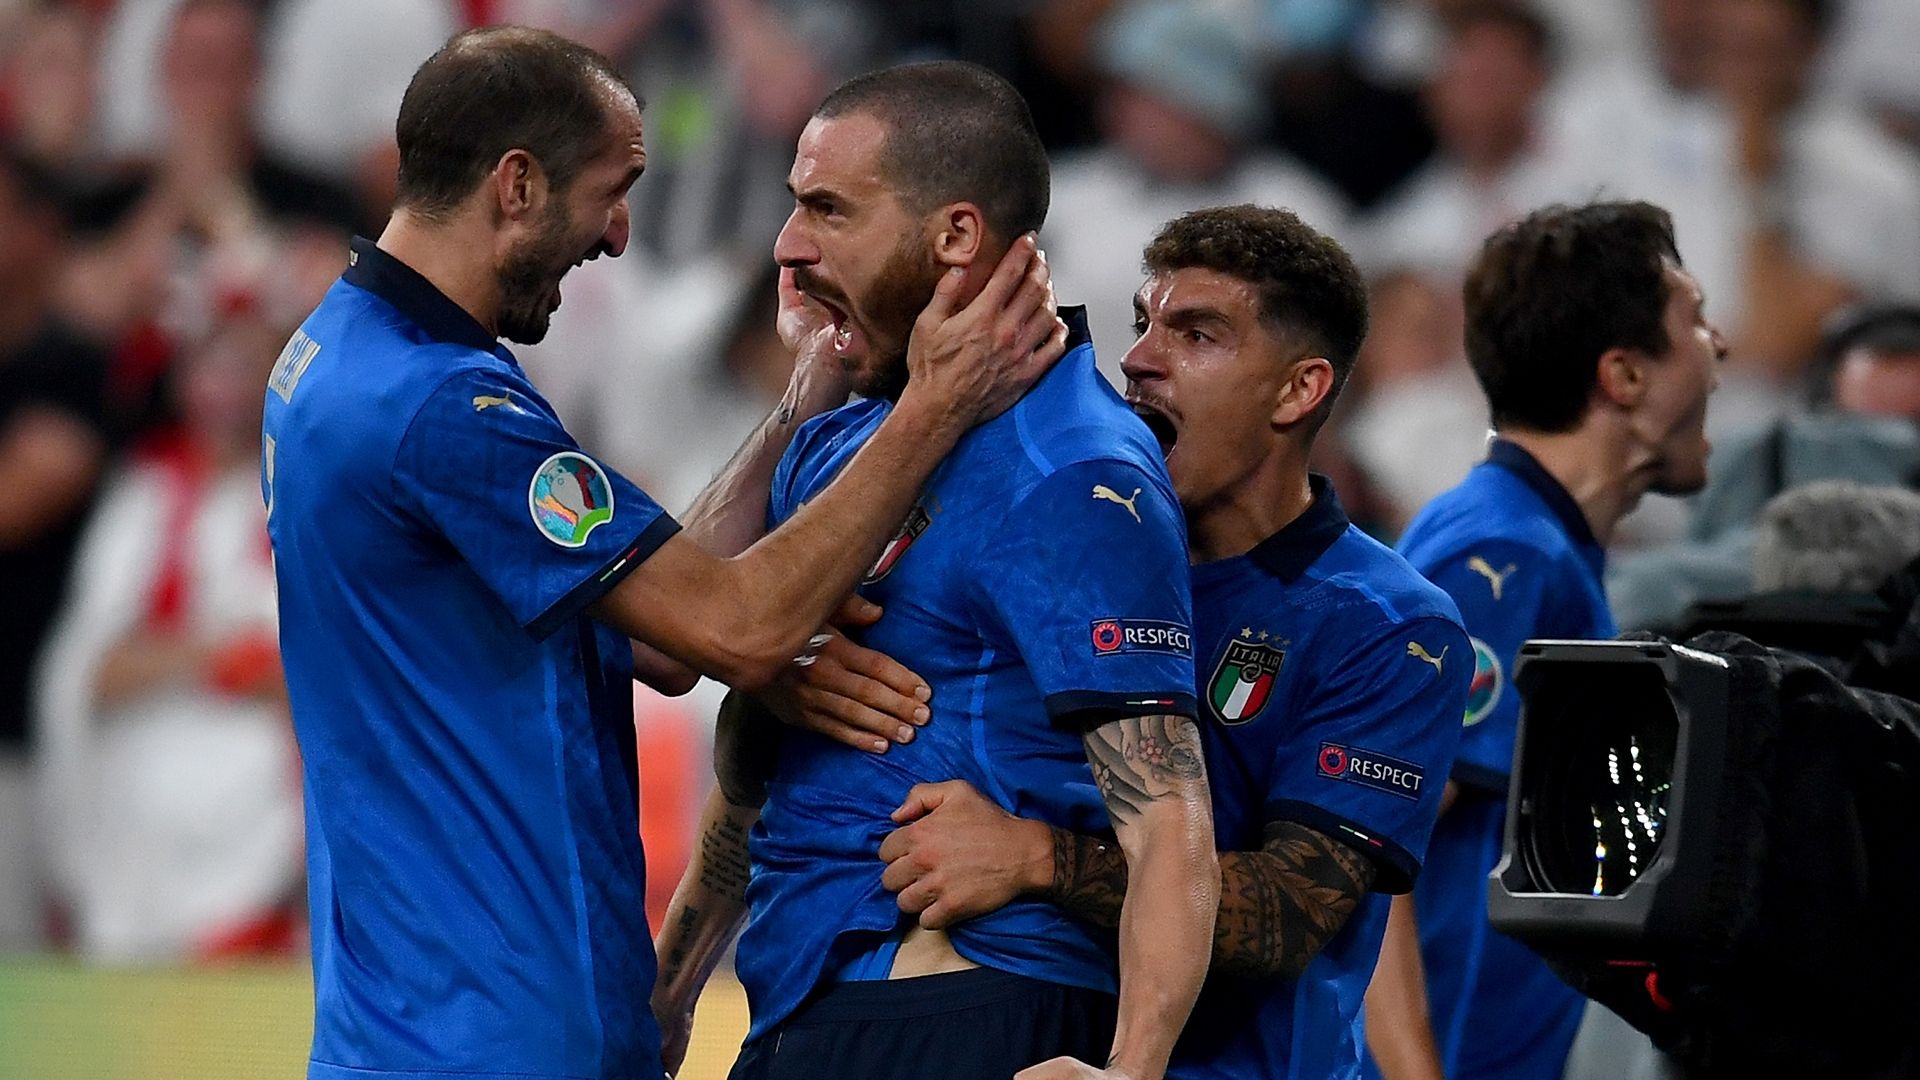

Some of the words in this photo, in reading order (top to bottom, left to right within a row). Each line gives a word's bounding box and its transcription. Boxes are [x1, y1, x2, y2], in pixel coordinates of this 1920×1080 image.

[1125, 628, 1190, 649] RESPECT
[1232, 647, 1280, 667] ITALIA
[1350, 757, 1423, 790] RESPECT
